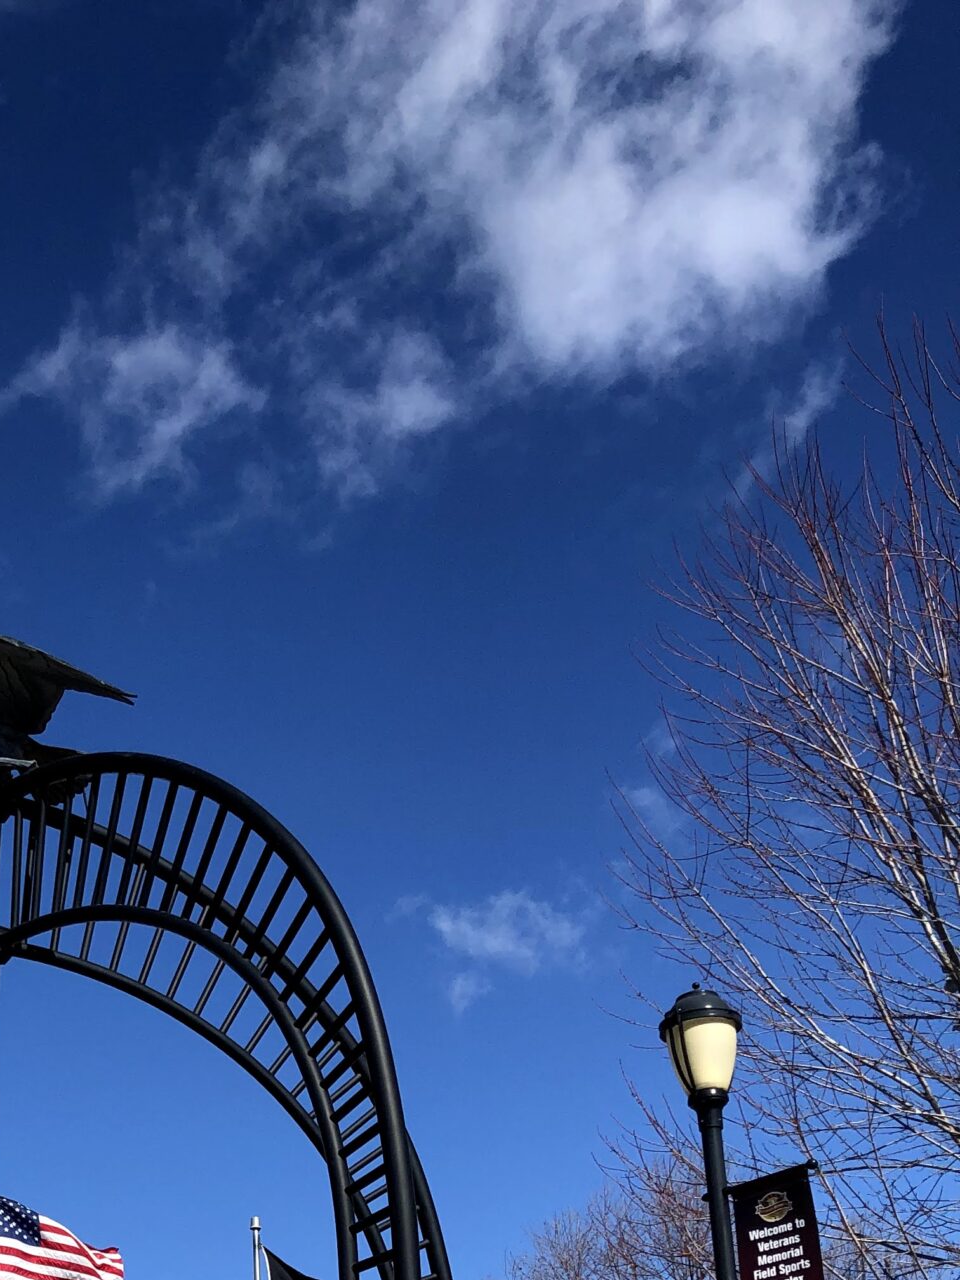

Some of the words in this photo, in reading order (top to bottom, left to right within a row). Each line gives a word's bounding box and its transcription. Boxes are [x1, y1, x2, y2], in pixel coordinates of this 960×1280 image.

[748, 1222, 793, 1241] Welcome
[795, 1218, 806, 1228] to
[757, 1234, 801, 1252] Veterans
[757, 1245, 804, 1266] Memorial
[753, 1266, 777, 1280] Field
[779, 1259, 811, 1275] Sports
